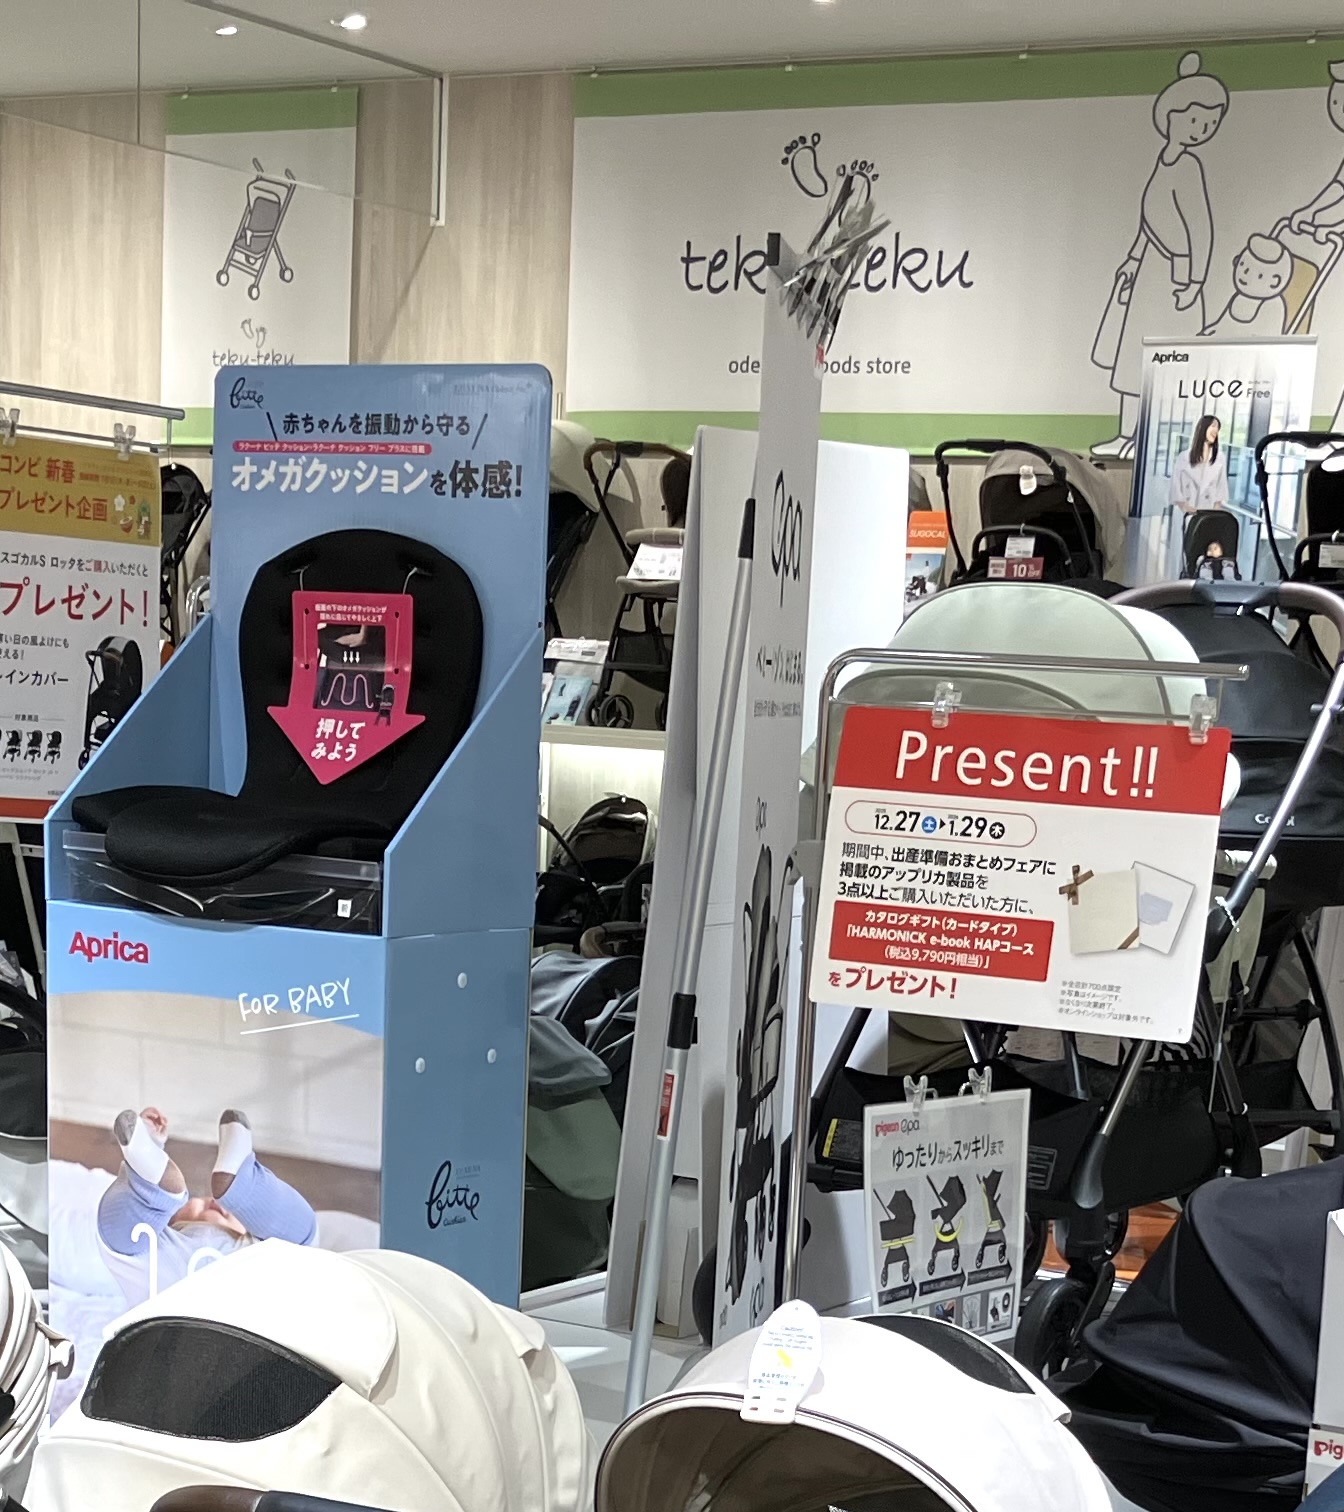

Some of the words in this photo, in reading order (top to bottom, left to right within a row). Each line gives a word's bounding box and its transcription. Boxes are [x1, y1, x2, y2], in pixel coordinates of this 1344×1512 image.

[866, 357, 911, 375] store
[1151, 351, 1189, 365] Aprica
[1246, 388, 1271, 399] Free
[282, 412, 472, 436] 赤ちゃんを振動から守る
[0, 453, 40, 479] コンビ
[45, 457, 76, 484] 新春
[0, 551, 46, 569] スゴカルS
[315, 718, 365, 740] 押して
[311, 740, 357, 762] みよう
[895, 730, 1159, 798] Present!!
[842, 841, 1057, 876] 期間中、出産準備おまとめフェアに
[839, 861, 989, 890] 掲載のアップリカ製品を
[68, 931, 149, 964] Aprica
[929, 934, 971, 949] e-book
[973, 938, 1035, 956] HAPコース
[288, 978, 352, 1012] BABY
[892, 1133, 1005, 1172] ゆったりからスッキリまで
